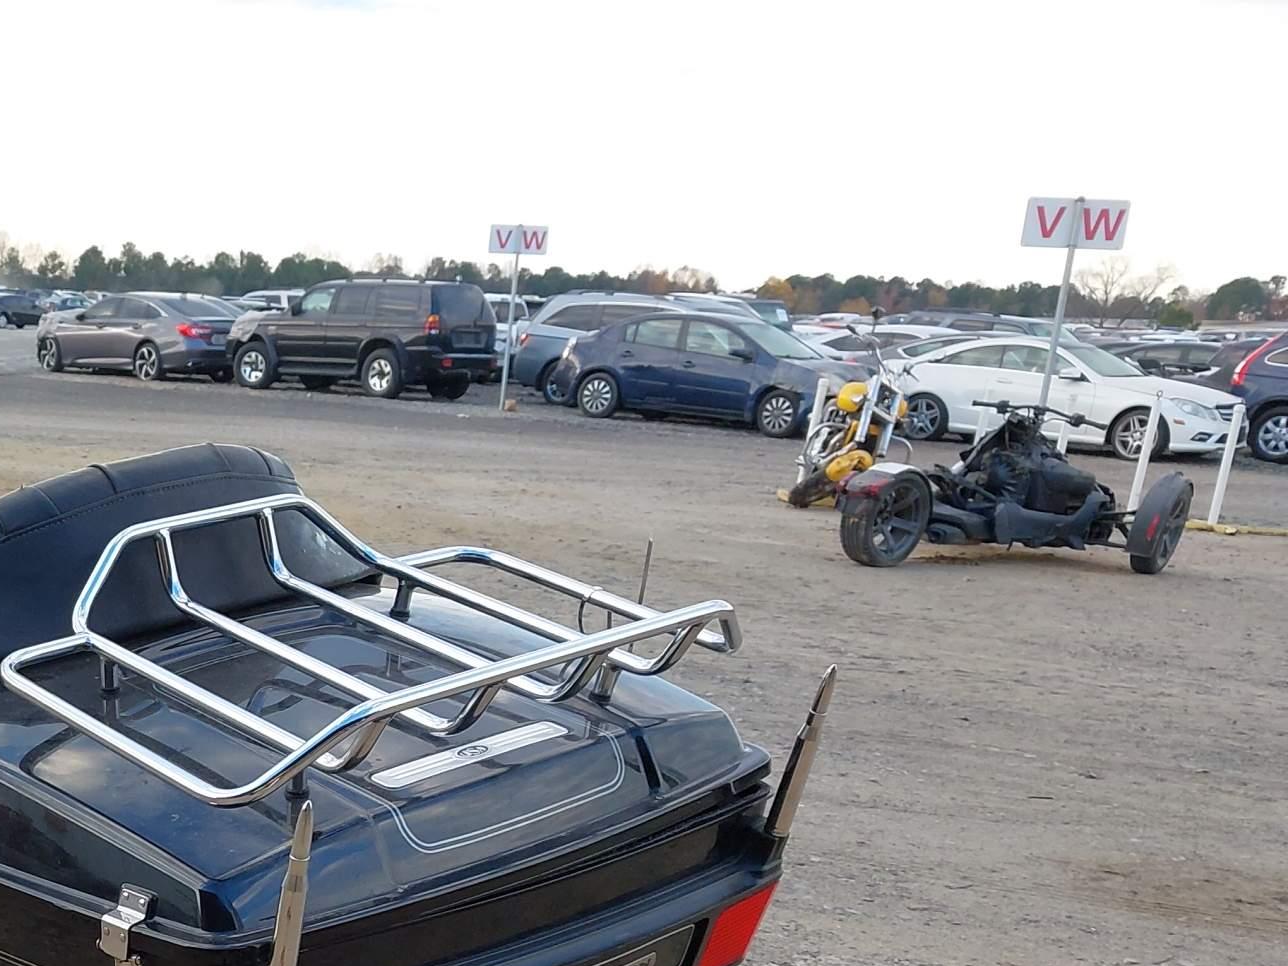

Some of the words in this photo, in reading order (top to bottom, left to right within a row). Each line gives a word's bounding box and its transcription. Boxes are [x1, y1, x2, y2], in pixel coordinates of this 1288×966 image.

[1036, 205, 1067, 239] V
[1082, 207, 1127, 241] W
[496, 229, 513, 249] V
[523, 230, 548, 250] W
